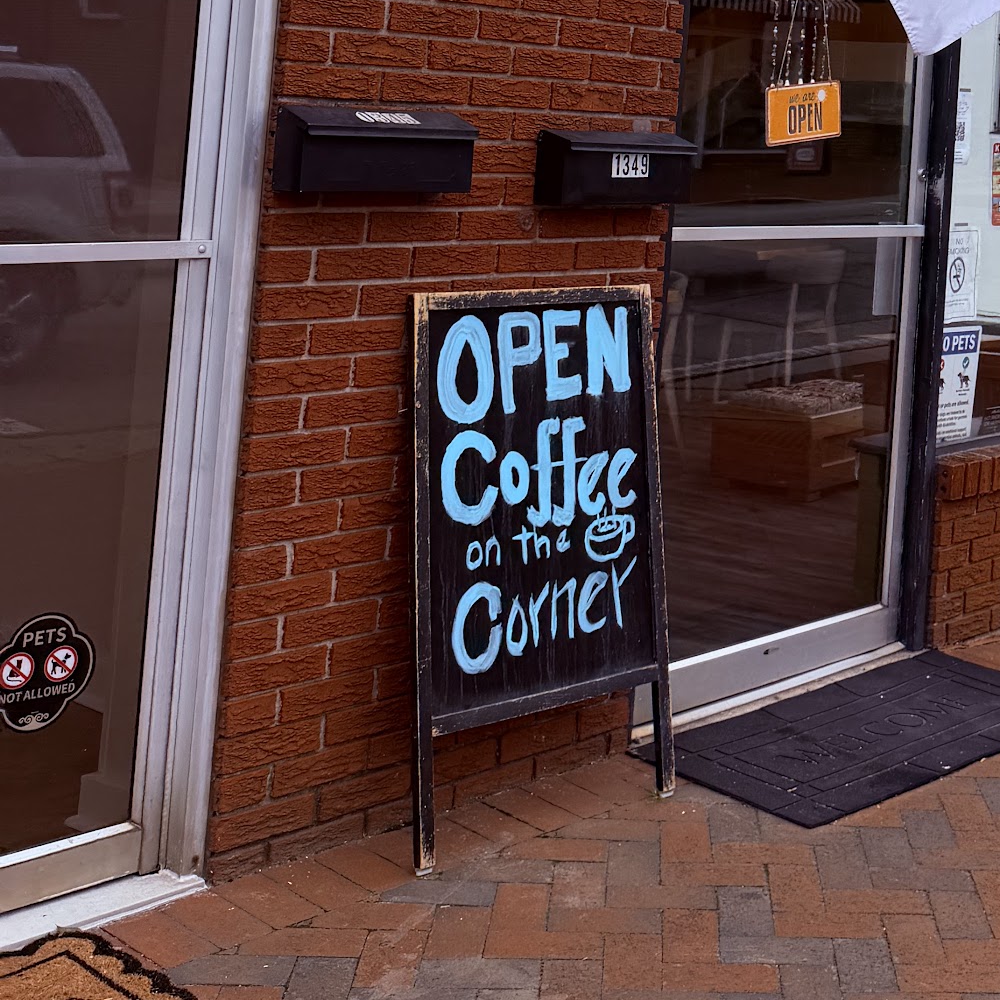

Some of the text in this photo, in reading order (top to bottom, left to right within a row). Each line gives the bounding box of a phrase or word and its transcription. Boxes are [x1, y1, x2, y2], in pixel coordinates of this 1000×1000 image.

[788, 101, 823, 136] OPEN
[613, 153, 649, 178] 1349
[951, 333, 977, 352] PETS
[437, 303, 632, 425] OPEN
[441, 416, 637, 527] Coffee
[465, 524, 571, 571] on the
[451, 555, 638, 675] Corner
[22, 626, 67, 648] PETS
[0, 682, 76, 705] NOT ALLOWED
[775, 693, 973, 768] WELCOME
